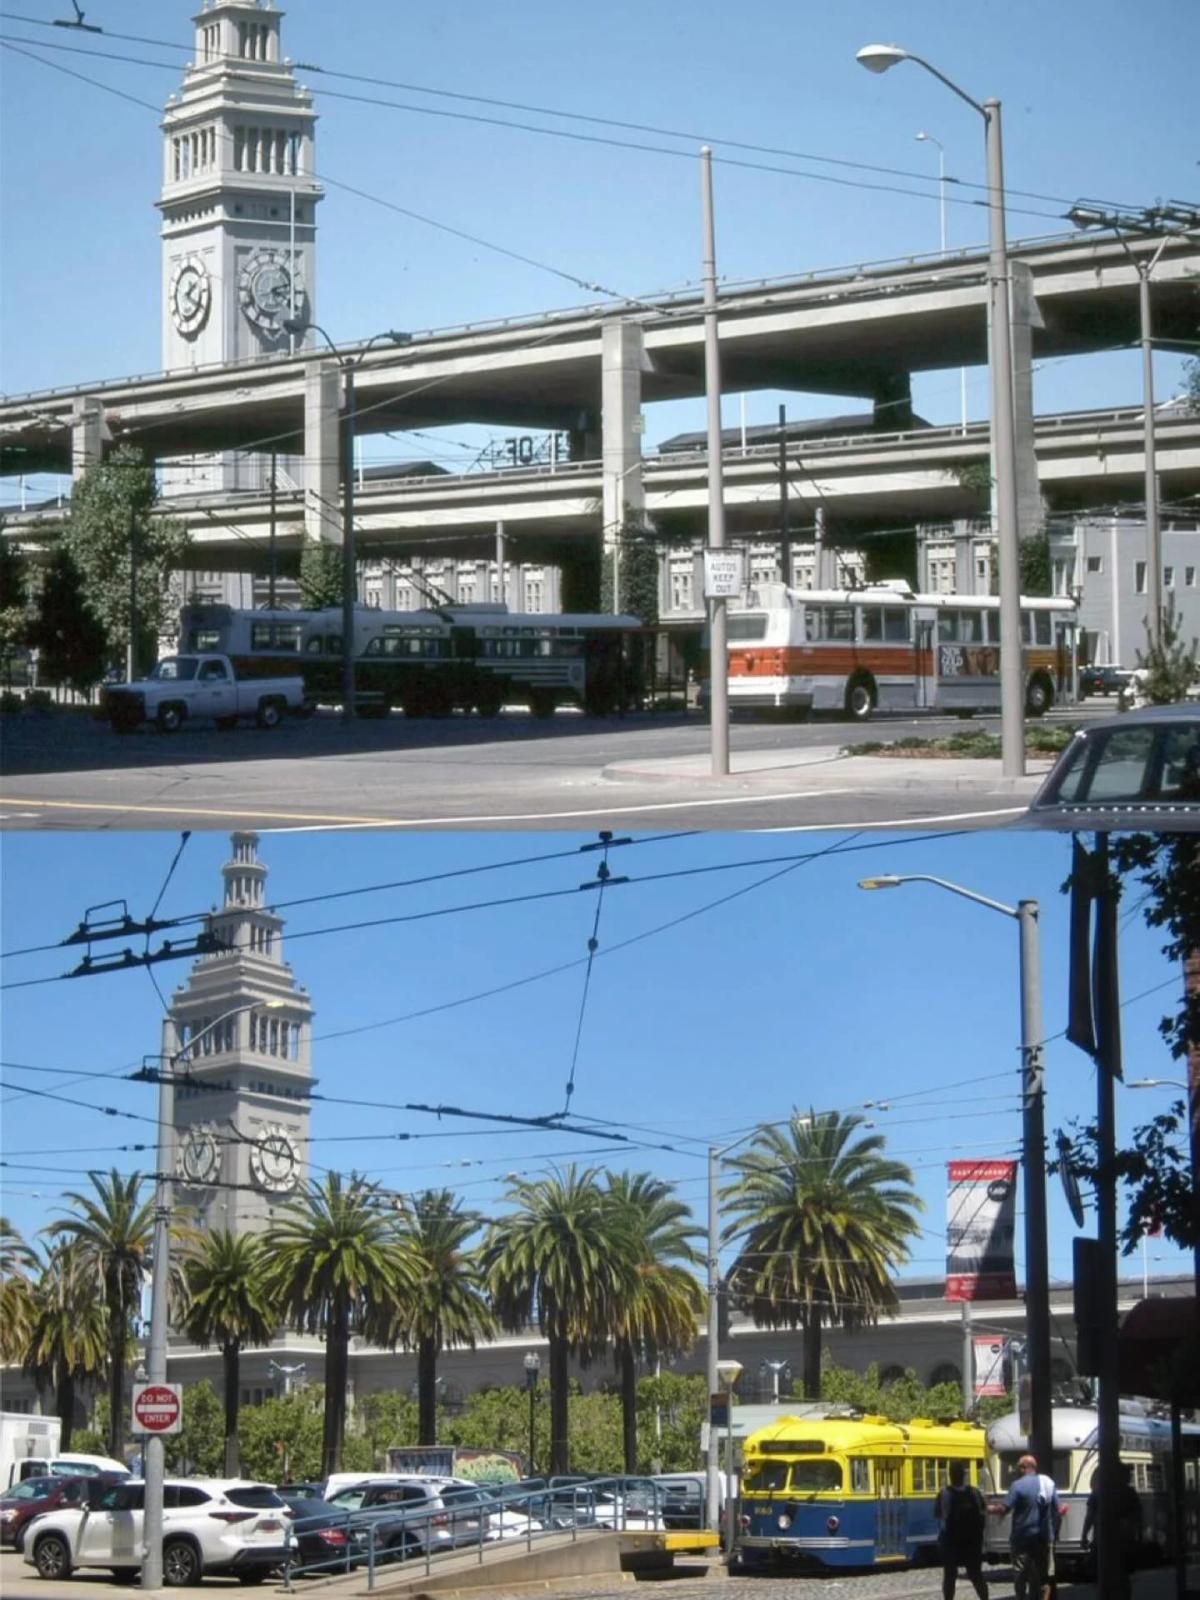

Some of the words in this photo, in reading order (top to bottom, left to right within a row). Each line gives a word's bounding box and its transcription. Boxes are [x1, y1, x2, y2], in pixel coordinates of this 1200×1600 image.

[711, 562, 737, 572] AUTOS
[713, 573, 734, 582] KEEP
[715, 584, 731, 593] OUT
[141, 1394, 153, 1403] DO
[156, 1394, 173, 1403] NOT
[144, 1414, 171, 1423] ENTER
